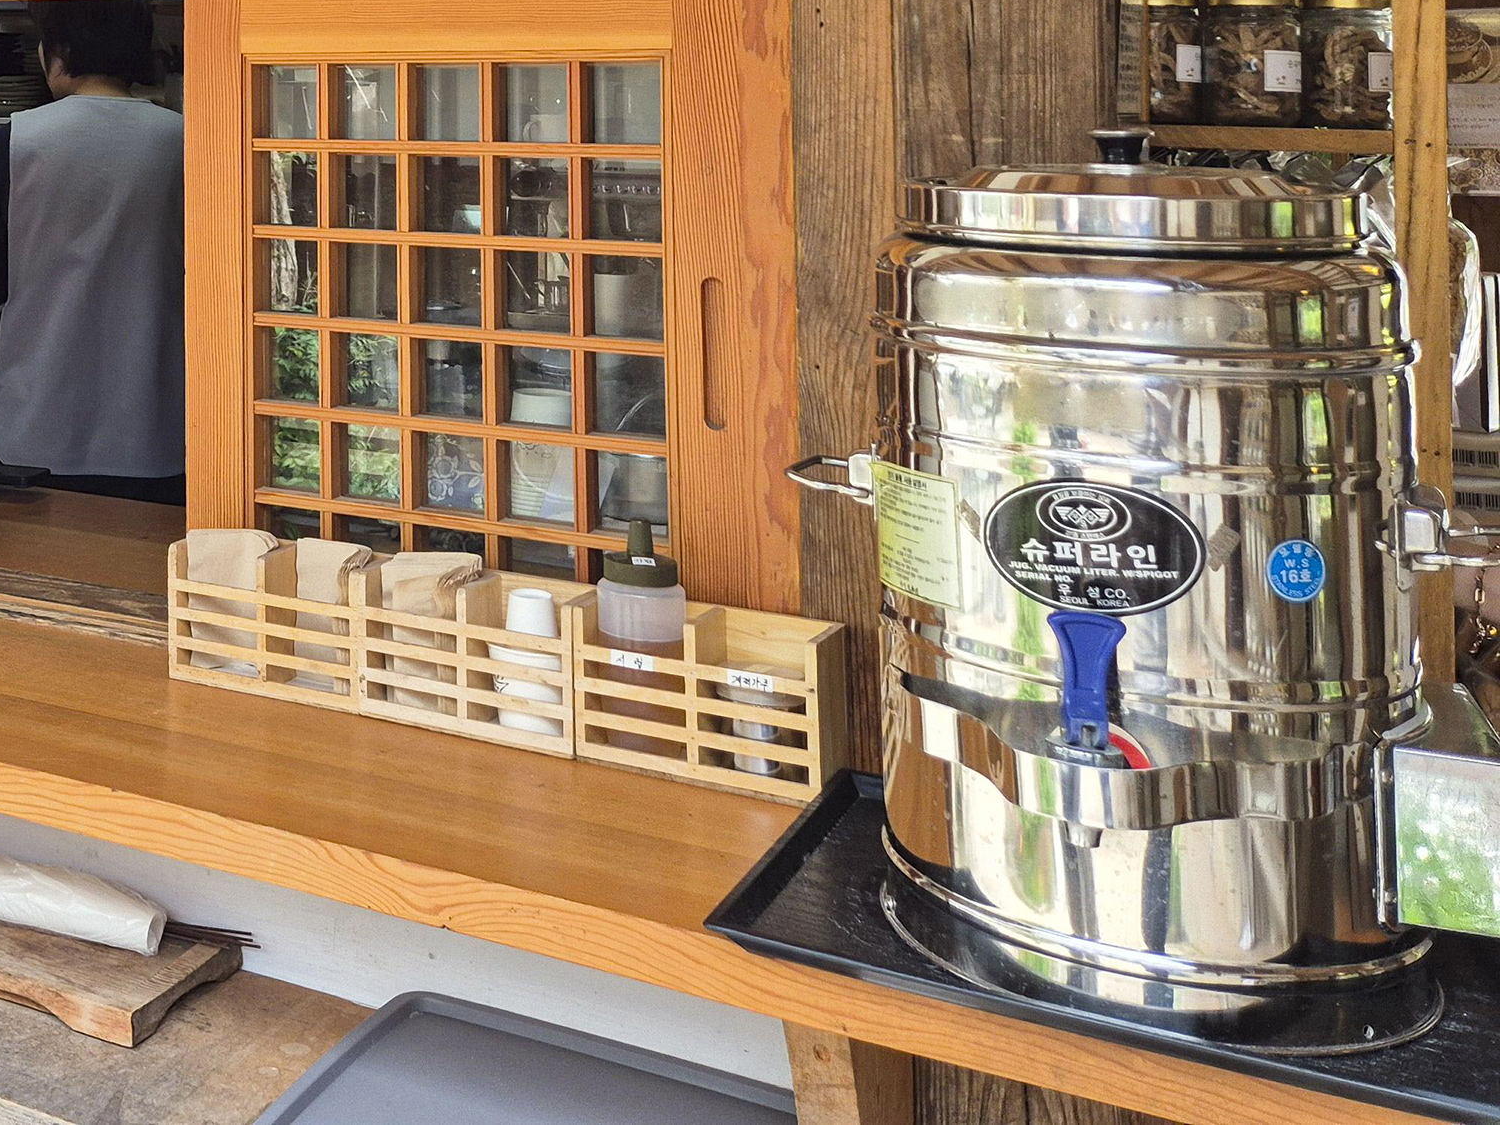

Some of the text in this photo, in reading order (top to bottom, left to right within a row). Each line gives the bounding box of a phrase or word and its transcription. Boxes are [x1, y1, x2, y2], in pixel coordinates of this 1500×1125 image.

[1019, 537, 1159, 570] 슈퍼라인
[1008, 560, 1033, 571] JUG.
[1034, 563, 1082, 575] VACUUM
[1014, 570, 1052, 582] SERIAL
[1104, 588, 1131, 601] CO.
[1097, 599, 1131, 608] KOREA
